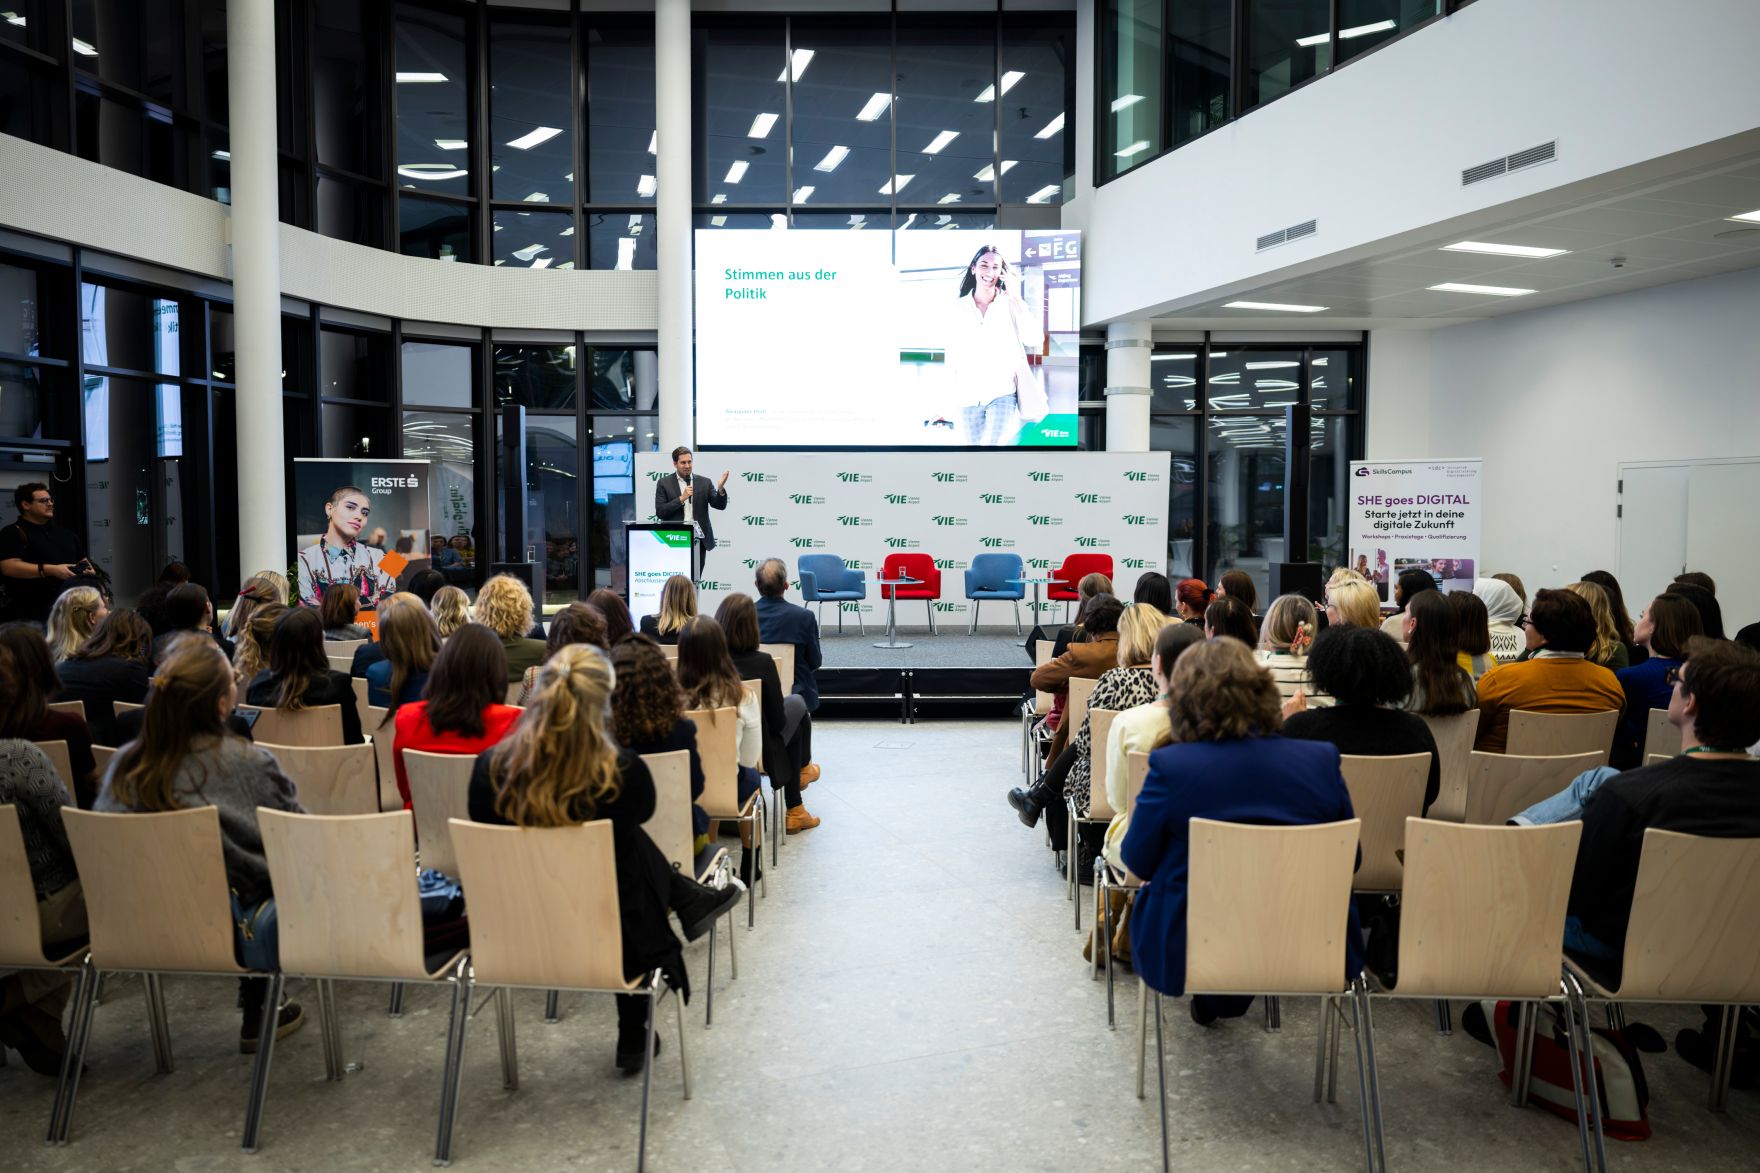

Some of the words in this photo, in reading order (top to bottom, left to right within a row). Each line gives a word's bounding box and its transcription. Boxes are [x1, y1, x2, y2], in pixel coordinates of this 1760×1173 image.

[725, 268, 784, 281] Stimmen
[788, 270, 810, 281] aus
[814, 268, 837, 281] der
[725, 287, 766, 300] Politik
[747, 473, 764, 482] VIE
[842, 473, 859, 482] VIE
[937, 472, 954, 482] VIE
[1033, 472, 1050, 481] VIE
[1129, 472, 1146, 481] VIE
[371, 478, 406, 487] ERSTE
[795, 495, 812, 504] VIE
[889, 494, 907, 504] VIE
[985, 494, 1002, 503] VIE
[1080, 494, 1098, 503] VIE
[1358, 496, 1382, 505] SHE
[1385, 498, 1414, 507] goes
[1416, 494, 1470, 505] DIGITAL
[1128, 515, 1145, 524] VIE
[1364, 510, 1396, 518] Starte
[1398, 510, 1421, 520] jetzt
[1424, 510, 1433, 518] in
[1436, 510, 1464, 518] deine
[747, 516, 765, 526] VIE
[842, 516, 860, 526] VIE
[937, 516, 954, 525] VIE
[1032, 516, 1050, 525] VIE
[1373, 520, 1412, 530] digitale
[1414, 520, 1455, 529] Zukunft
[795, 538, 812, 548] VIE
[889, 538, 907, 547] VIE
[984, 538, 1002, 547] VIE
[1079, 537, 1097, 546] VIE
[937, 559, 954, 568] VIE
[1031, 559, 1049, 568] VIE
[1126, 559, 1144, 568] VIE
[701, 581, 718, 590] VIE
[842, 602, 859, 612] VIE
[937, 602, 954, 612] VIE
